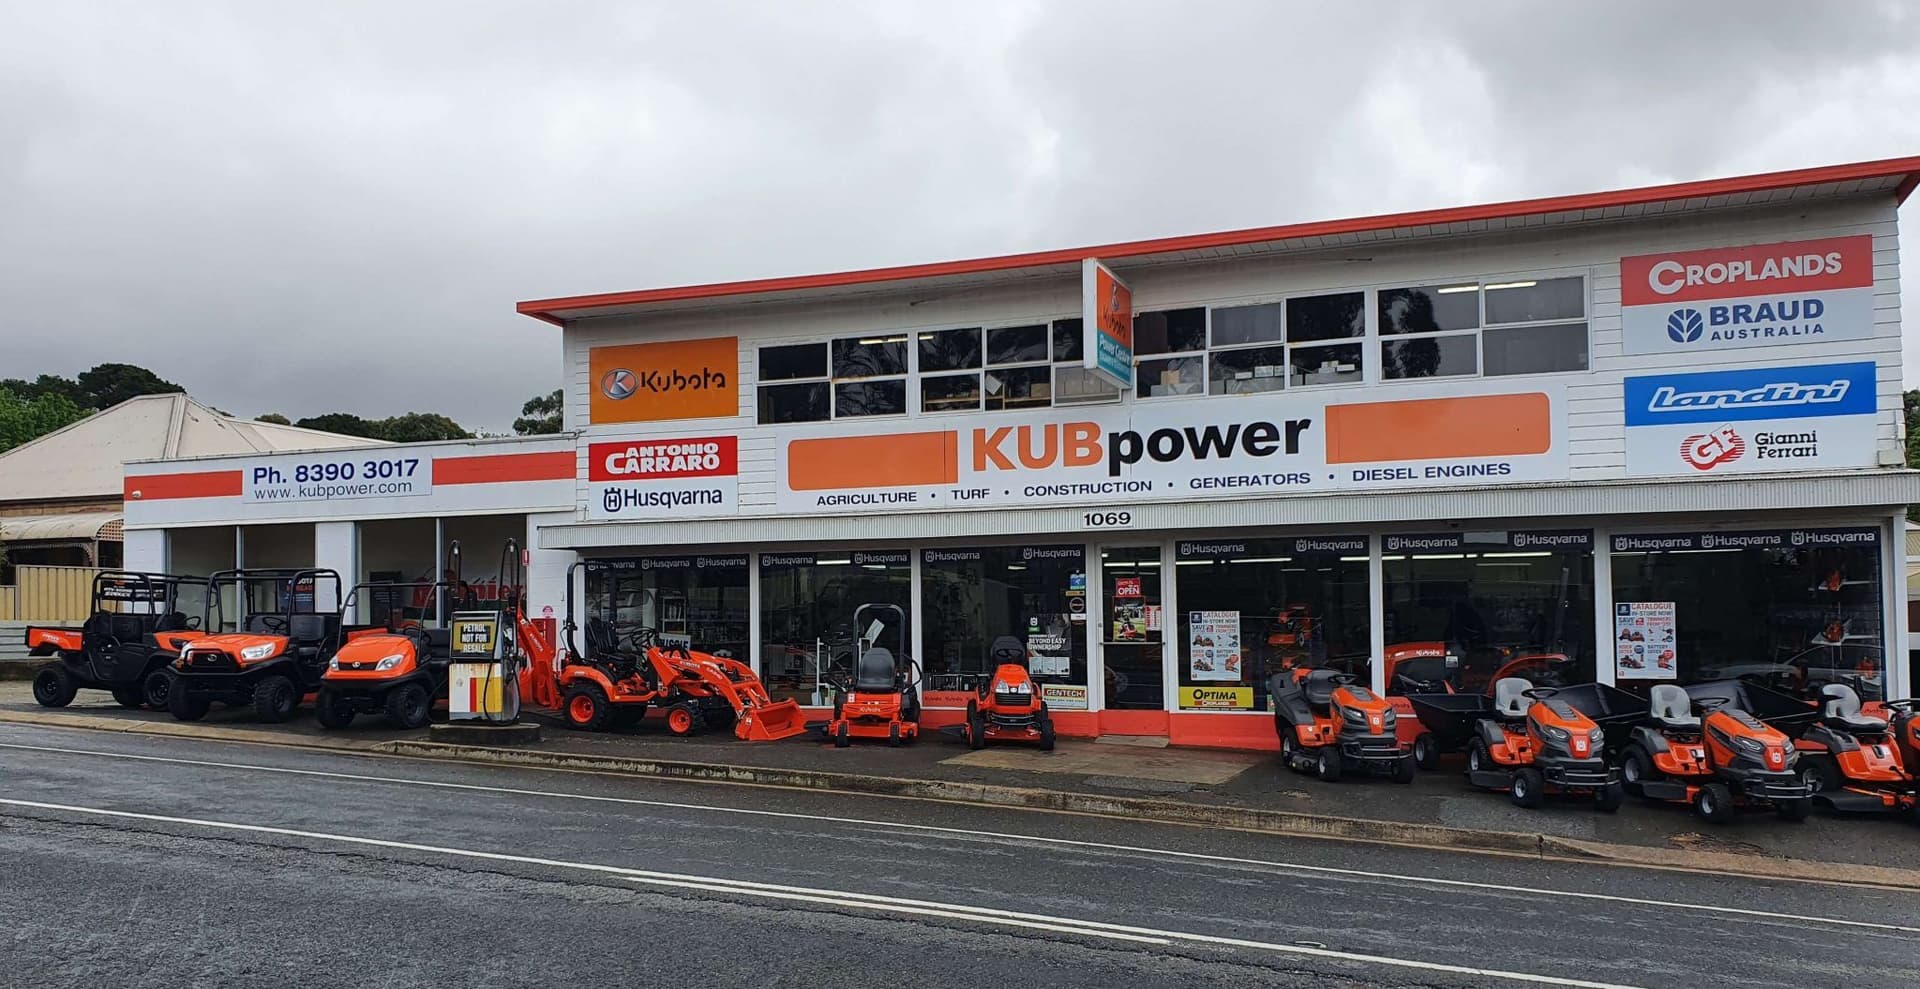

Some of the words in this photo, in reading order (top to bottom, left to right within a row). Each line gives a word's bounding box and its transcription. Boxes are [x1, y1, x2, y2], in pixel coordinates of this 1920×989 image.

[1648, 252, 1842, 295] CROPLANDS
[1709, 299, 1824, 326] BRAUD
[1711, 323, 1824, 341] AUSTRALIA
[641, 367, 726, 393] Kubota
[1755, 430, 1818, 446] Gianni
[625, 442, 719, 458] ANTONIO
[973, 417, 1312, 476] KUBpower
[1757, 444, 1818, 459] Ferrari
[605, 452, 720, 475] CARRARO
[254, 467, 287, 485] Ph.
[295, 462, 355, 483] 8390
[363, 458, 419, 479] 3017
[817, 491, 917, 506] AGRICULTURE
[951, 488, 990, 500] TURF
[1024, 480, 1152, 497] CONSTRUCTION
[1189, 472, 1311, 490] GENERATORS
[1353, 467, 1419, 482] DIESEL
[1425, 462, 1511, 478] ENGINES
[624, 488, 723, 509] Husqvarna
[1084, 512, 1132, 527] 1069
[1401, 537, 1458, 550] Husqvarna
[1526, 534, 1587, 546] Husqvarna
[1628, 537, 1691, 549] Husqvarna
[1715, 534, 1781, 547] Husqvarna
[1805, 531, 1875, 544] Husqvarna
[1192, 543, 1244, 555] Husqvarna
[1308, 540, 1363, 551] Husqvarna
[864, 553, 907, 564] Husqvarna
[934, 551, 980, 562] Husqvarna
[1033, 548, 1081, 559] Husqvarna
[650, 559, 690, 569] Husqvarna
[705, 557, 746, 568] Husqvarna
[771, 556, 813, 567] Husqvarna
[1118, 587, 1140, 595] OPEN
[463, 624, 486, 632] PETROL
[462, 634, 474, 642] NOT
[475, 634, 487, 642] FOR
[463, 643, 487, 653] RESALE
[1193, 689, 1237, 700] OPTIMA
